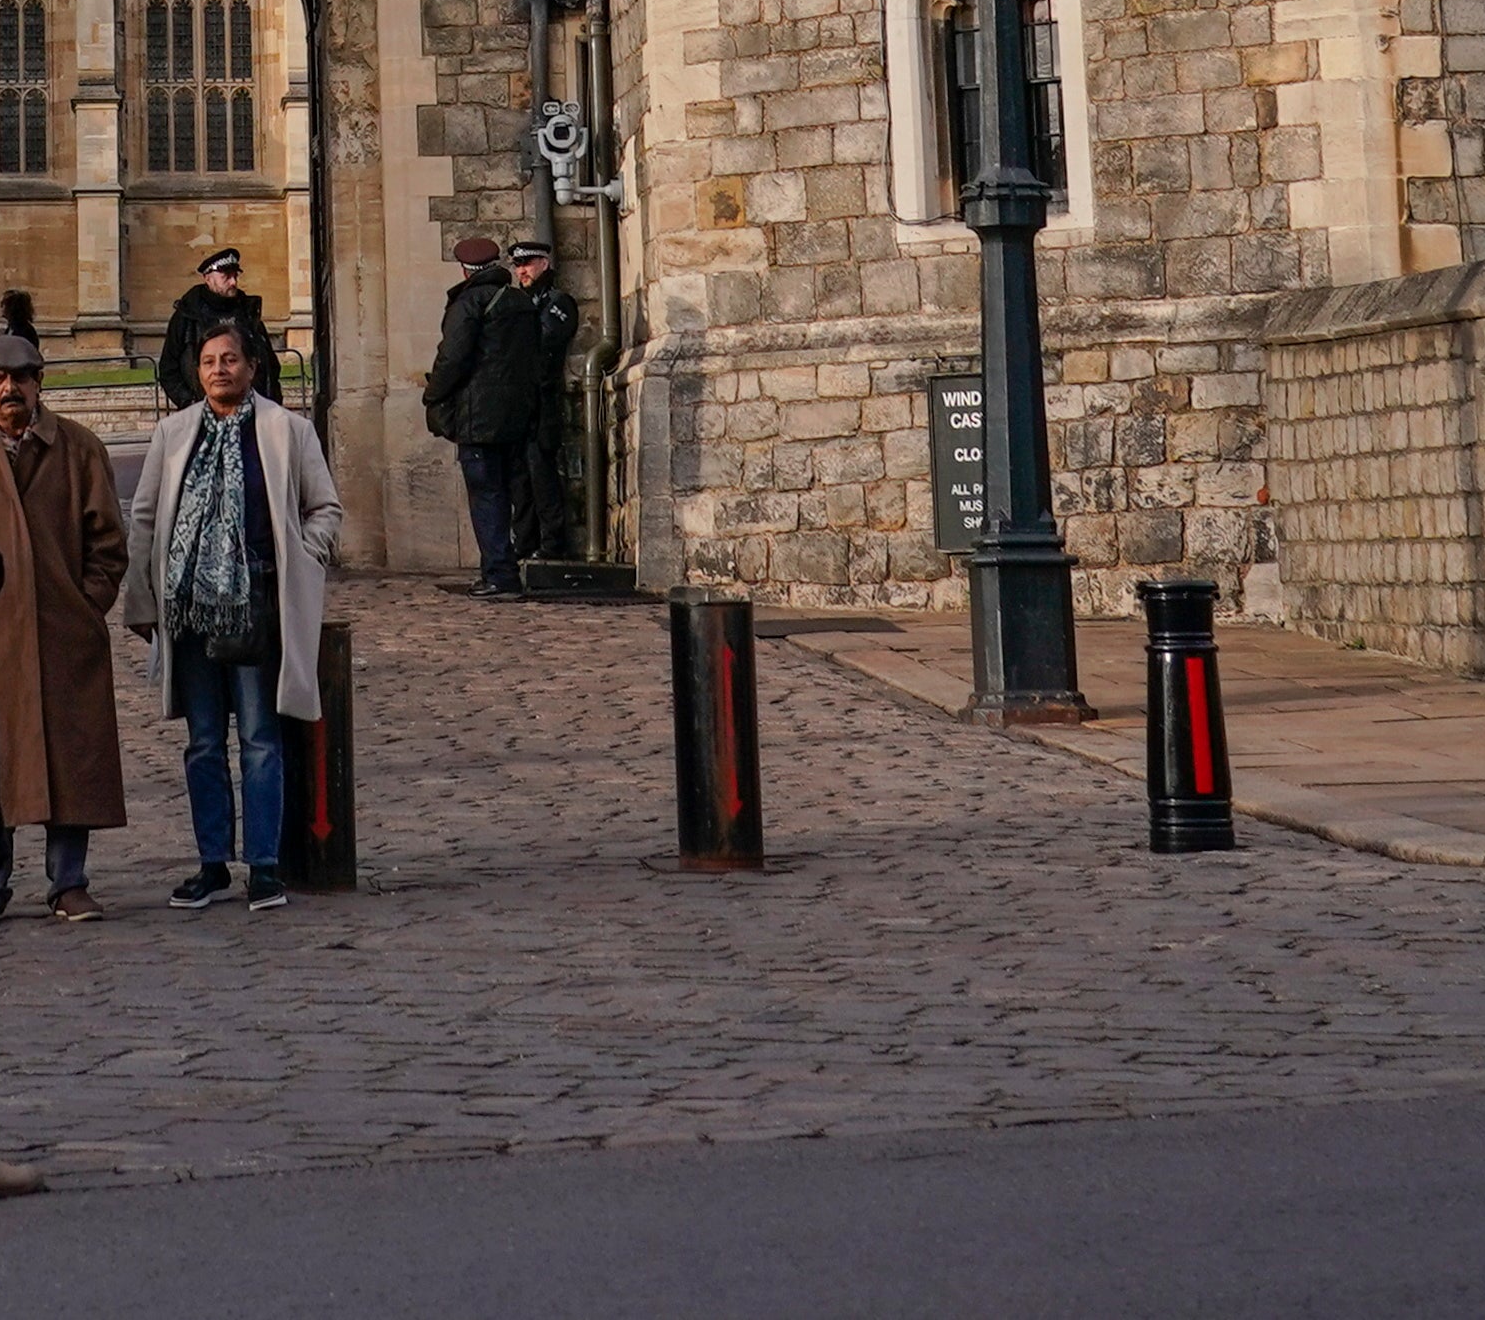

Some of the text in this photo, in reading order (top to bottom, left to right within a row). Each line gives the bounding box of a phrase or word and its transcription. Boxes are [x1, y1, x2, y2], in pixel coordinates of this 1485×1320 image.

[942, 391, 982, 407] WIND
[950, 412, 983, 429] CAS
[954, 447, 983, 462] CLO
[951, 483, 971, 496] ALL
